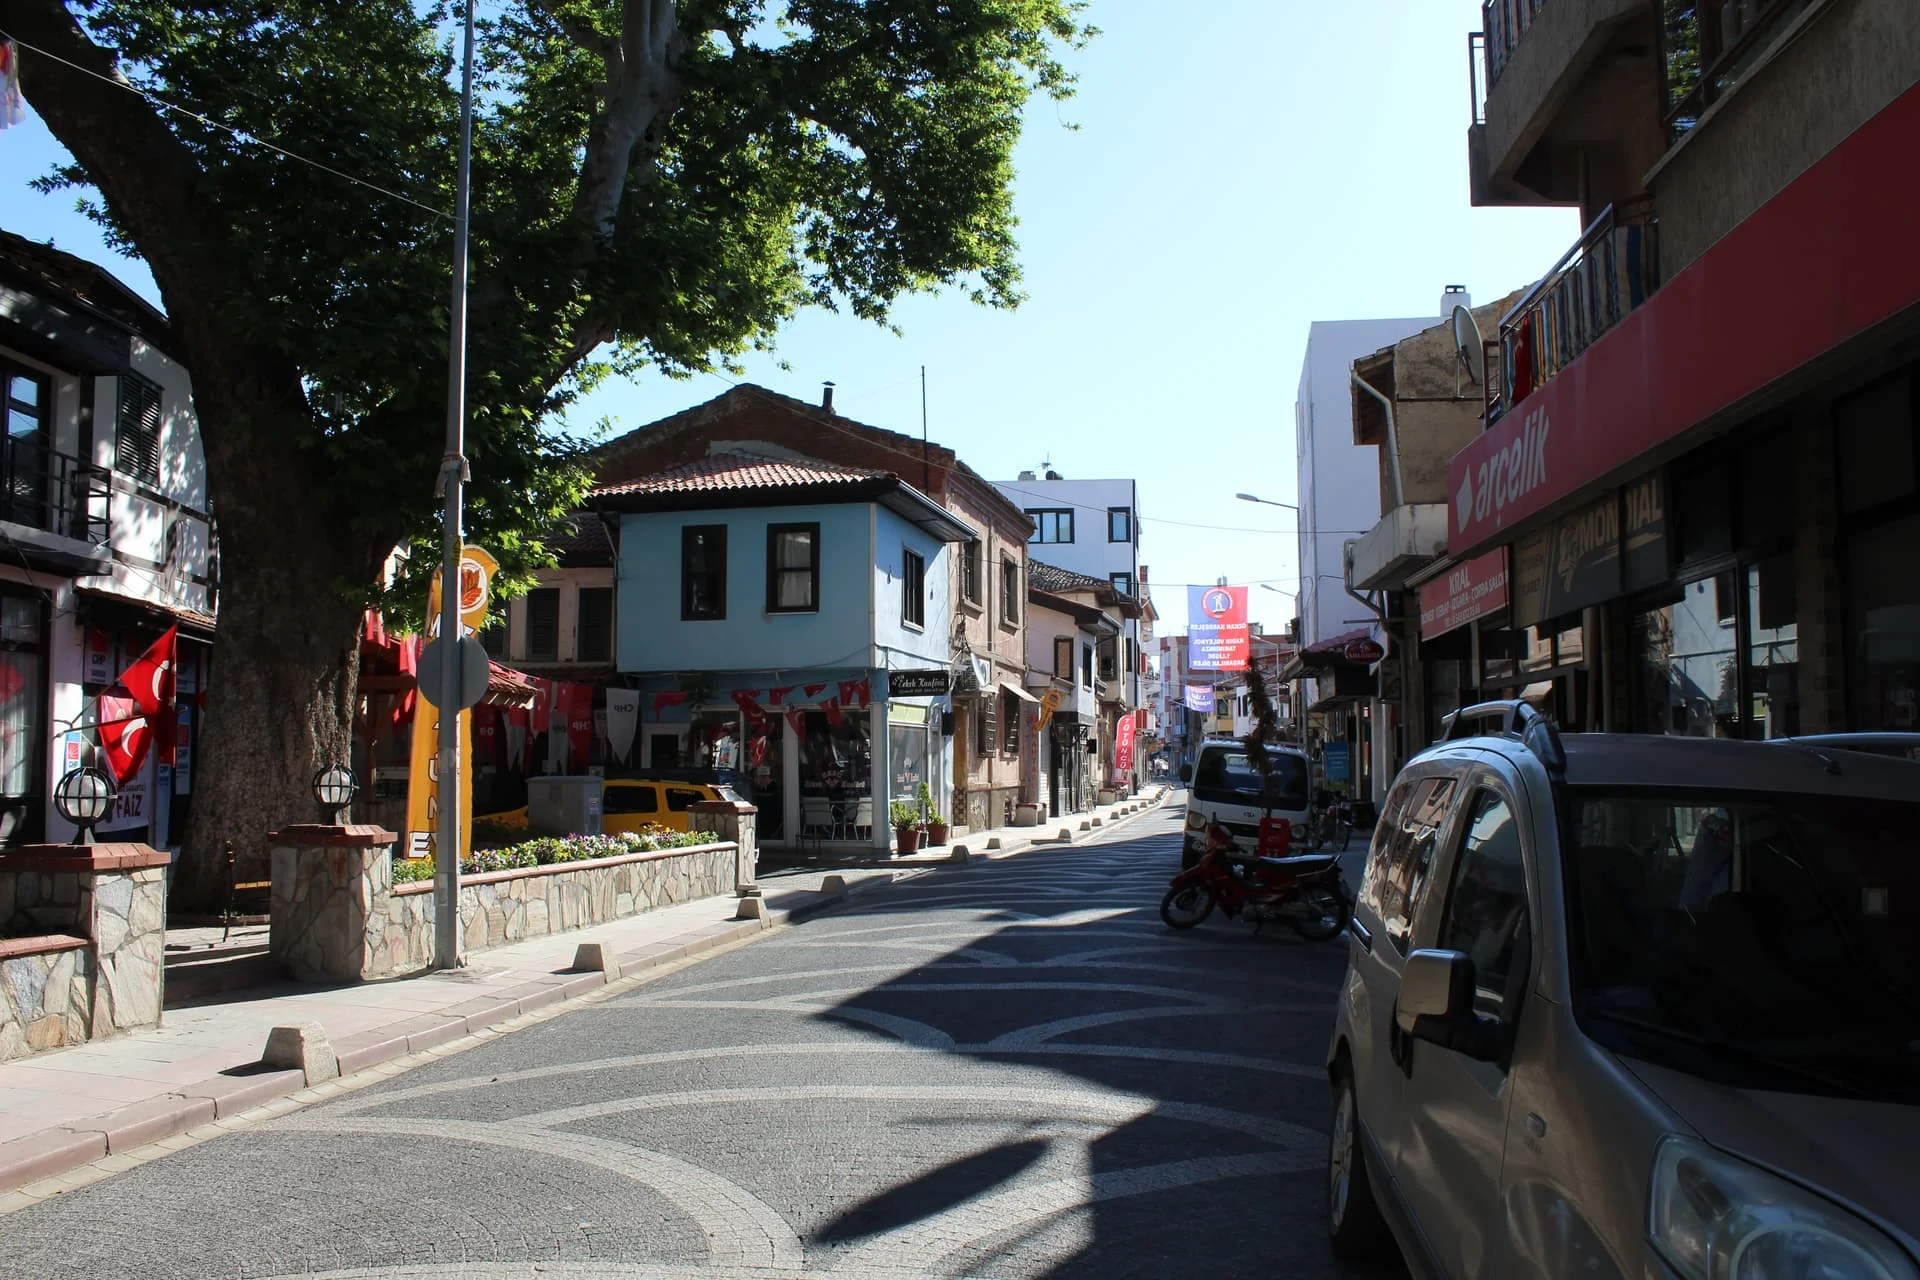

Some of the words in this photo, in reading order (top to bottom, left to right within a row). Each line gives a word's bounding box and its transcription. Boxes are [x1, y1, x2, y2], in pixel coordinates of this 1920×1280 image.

[1476, 404, 1549, 527] arçelik
[1449, 566, 1470, 597] KRAL
[117, 793, 143, 818] FAİZ
